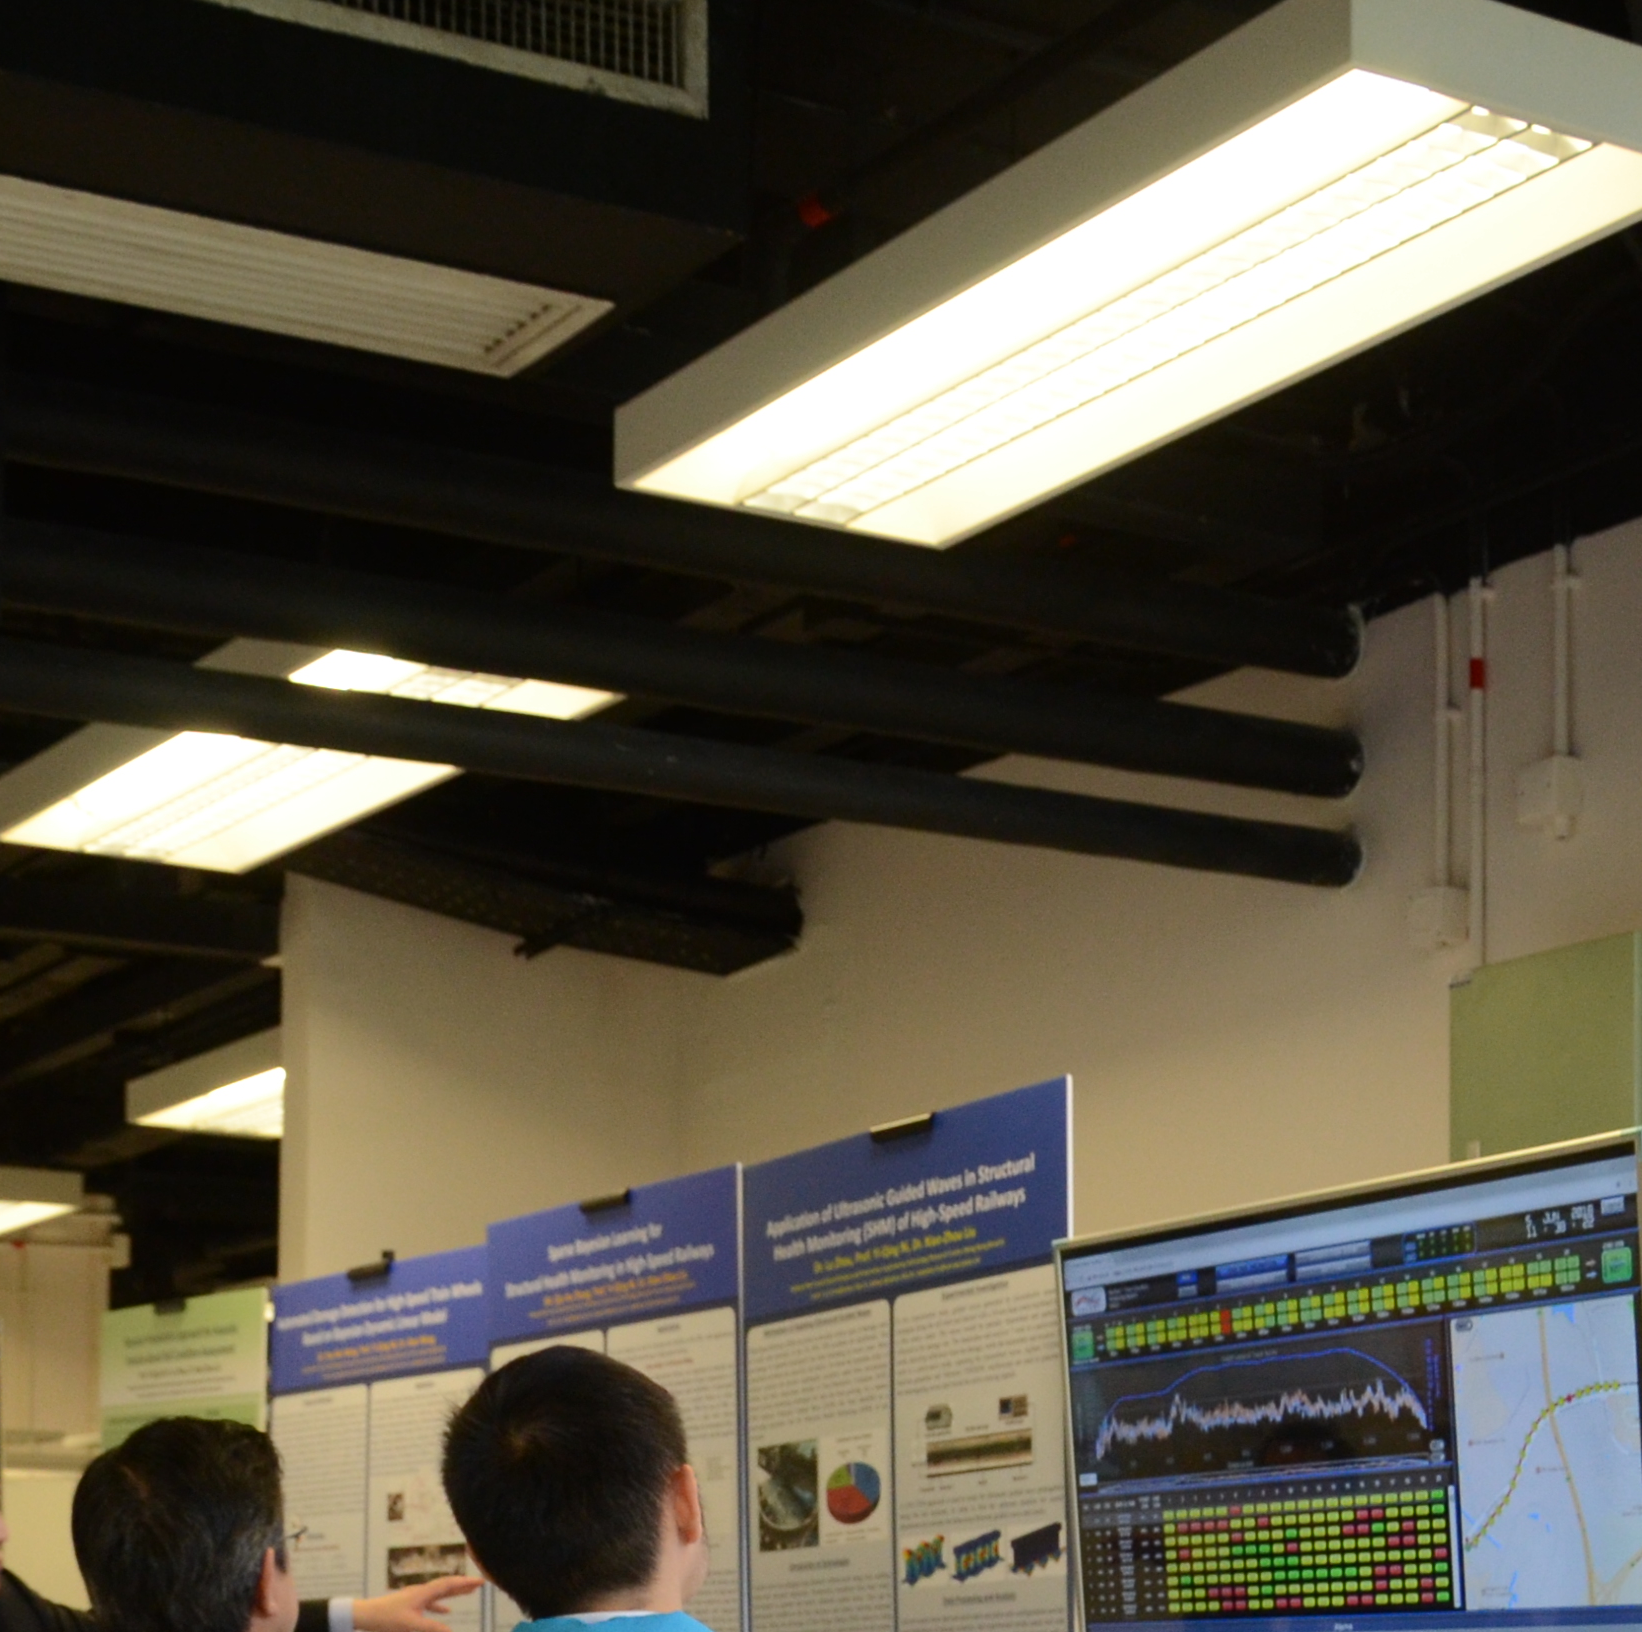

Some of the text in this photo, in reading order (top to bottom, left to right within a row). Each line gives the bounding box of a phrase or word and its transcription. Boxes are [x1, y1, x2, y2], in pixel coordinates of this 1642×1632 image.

[821, 1205, 832, 1223] of
[886, 1183, 924, 1208] Guided
[926, 1177, 962, 1198] Waves
[964, 1172, 976, 1189] in
[978, 1155, 1035, 1186] Structural
[897, 1215, 908, 1233] of
[910, 1199, 973, 1230] High-Speed
[975, 1191, 1025, 1214] Railways
